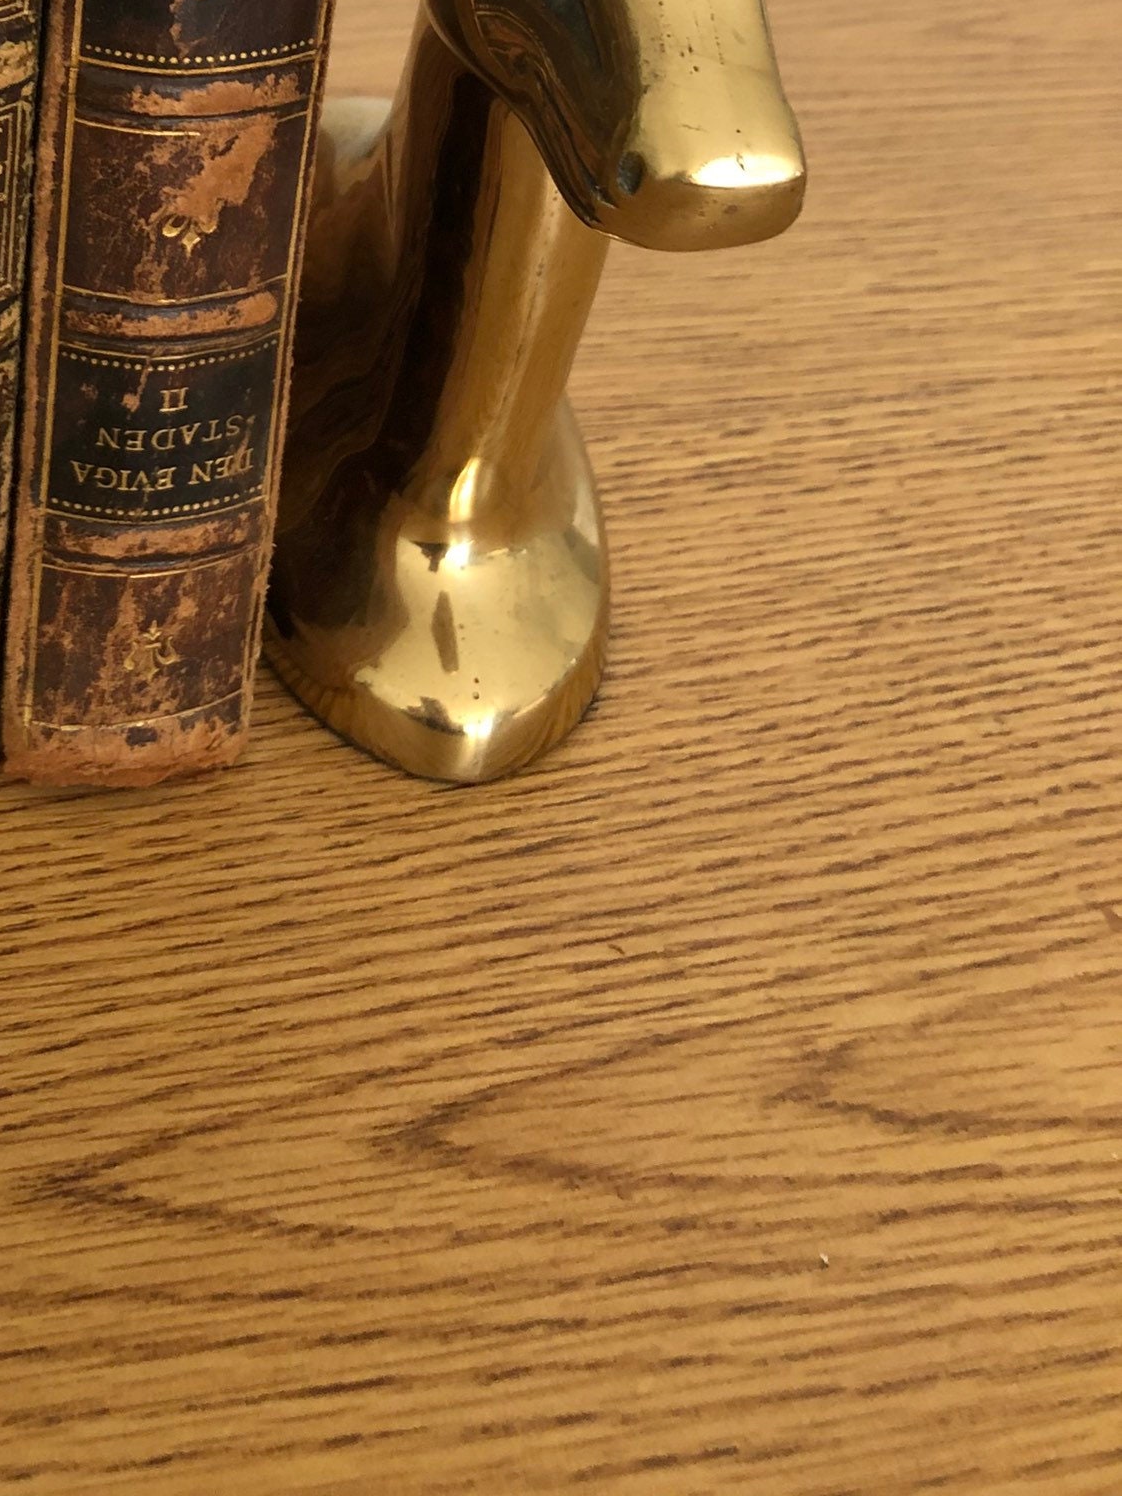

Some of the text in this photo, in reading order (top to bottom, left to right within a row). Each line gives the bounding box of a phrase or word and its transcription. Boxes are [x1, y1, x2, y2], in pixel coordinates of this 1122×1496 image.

[95, 414, 246, 451] STADEN
[69, 447, 254, 492] DEN EVIGA
